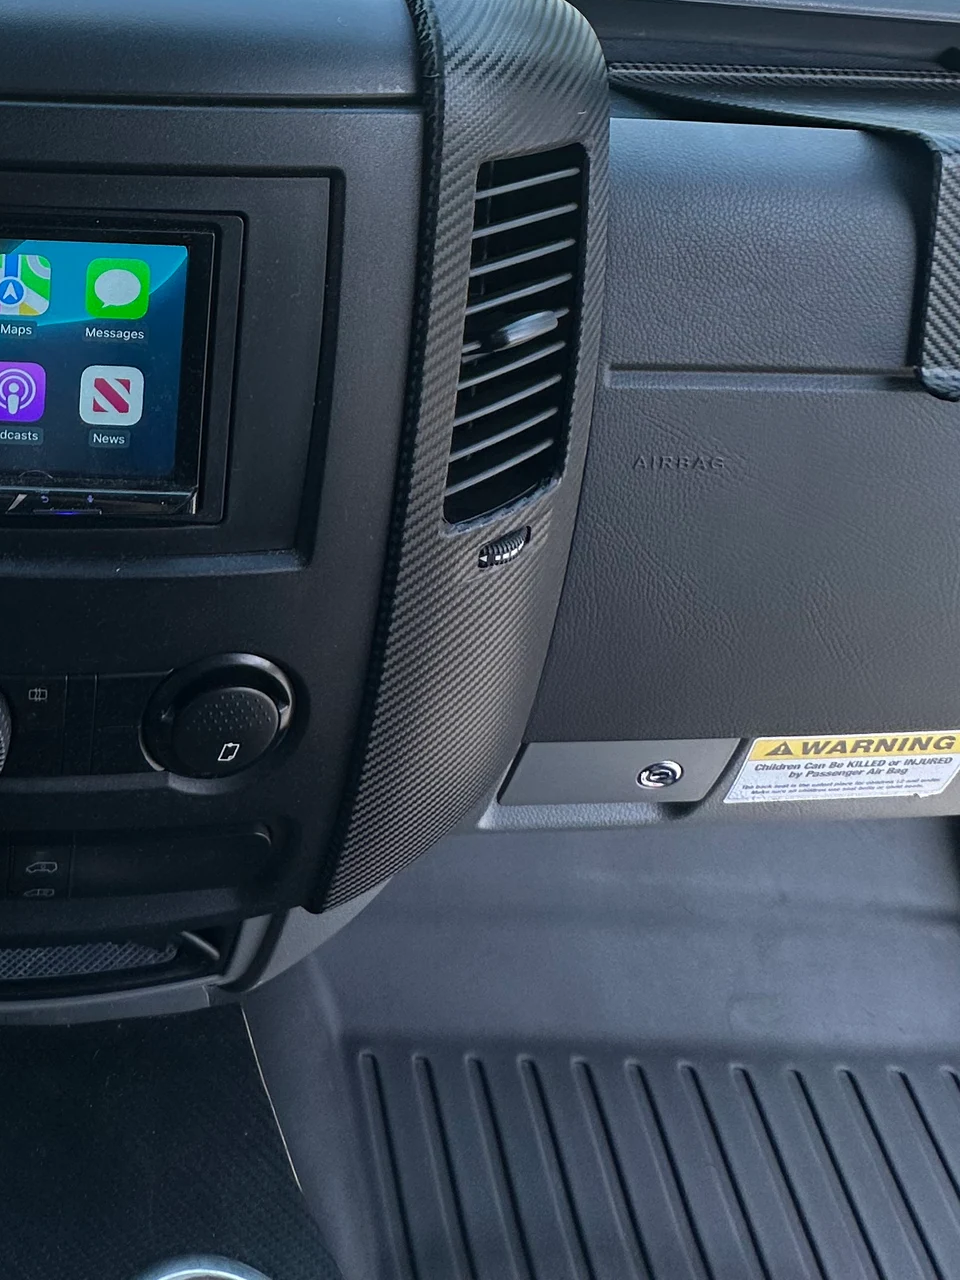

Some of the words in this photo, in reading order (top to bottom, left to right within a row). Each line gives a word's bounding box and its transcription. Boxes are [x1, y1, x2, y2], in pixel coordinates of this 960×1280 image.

[0, 323, 33, 337] Maps
[85, 327, 145, 341] Messages
[93, 433, 126, 445] News
[631, 455, 725, 470] AIRBAG
[802, 735, 957, 755] WARNING
[754, 763, 801, 771] Children
[804, 762, 826, 770] Can
[829, 761, 844, 769] Be
[846, 759, 886, 768] KILLED
[904, 757, 953, 766] INJURED
[788, 771, 803, 779] by
[805, 769, 865, 778] Passenger
[866, 767, 884, 775] Air
[886, 767, 909, 775] Bag
